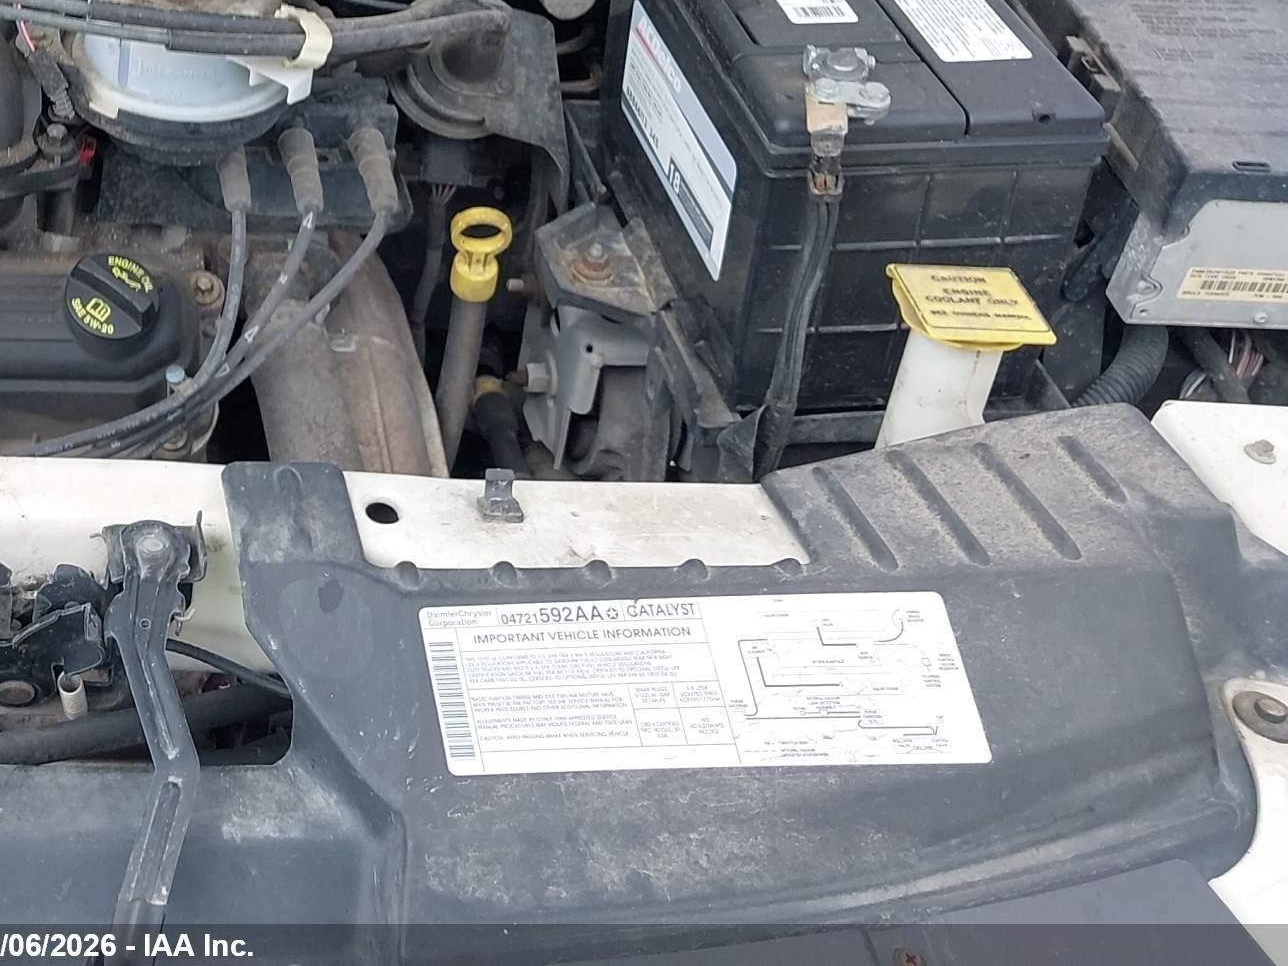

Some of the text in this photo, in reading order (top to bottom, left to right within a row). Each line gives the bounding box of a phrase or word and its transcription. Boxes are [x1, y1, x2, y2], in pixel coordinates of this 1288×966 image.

[668, 162, 681, 194] 18
[108, 256, 153, 293] ENGINE OIL
[931, 275, 986, 283] CAUTION
[925, 295, 1019, 306] COOLANT ONLY
[943, 288, 992, 297] ENGINE
[72, 298, 86, 318] SAE
[426, 609, 492, 619] DaimlerChrysler
[501, 605, 604, 625] 04721592AA
[626, 602, 697, 618] CATALYST
[428, 618, 478, 627] Corporation
[473, 627, 691, 644] IMPORTANT VEHICLE INFORMATION
